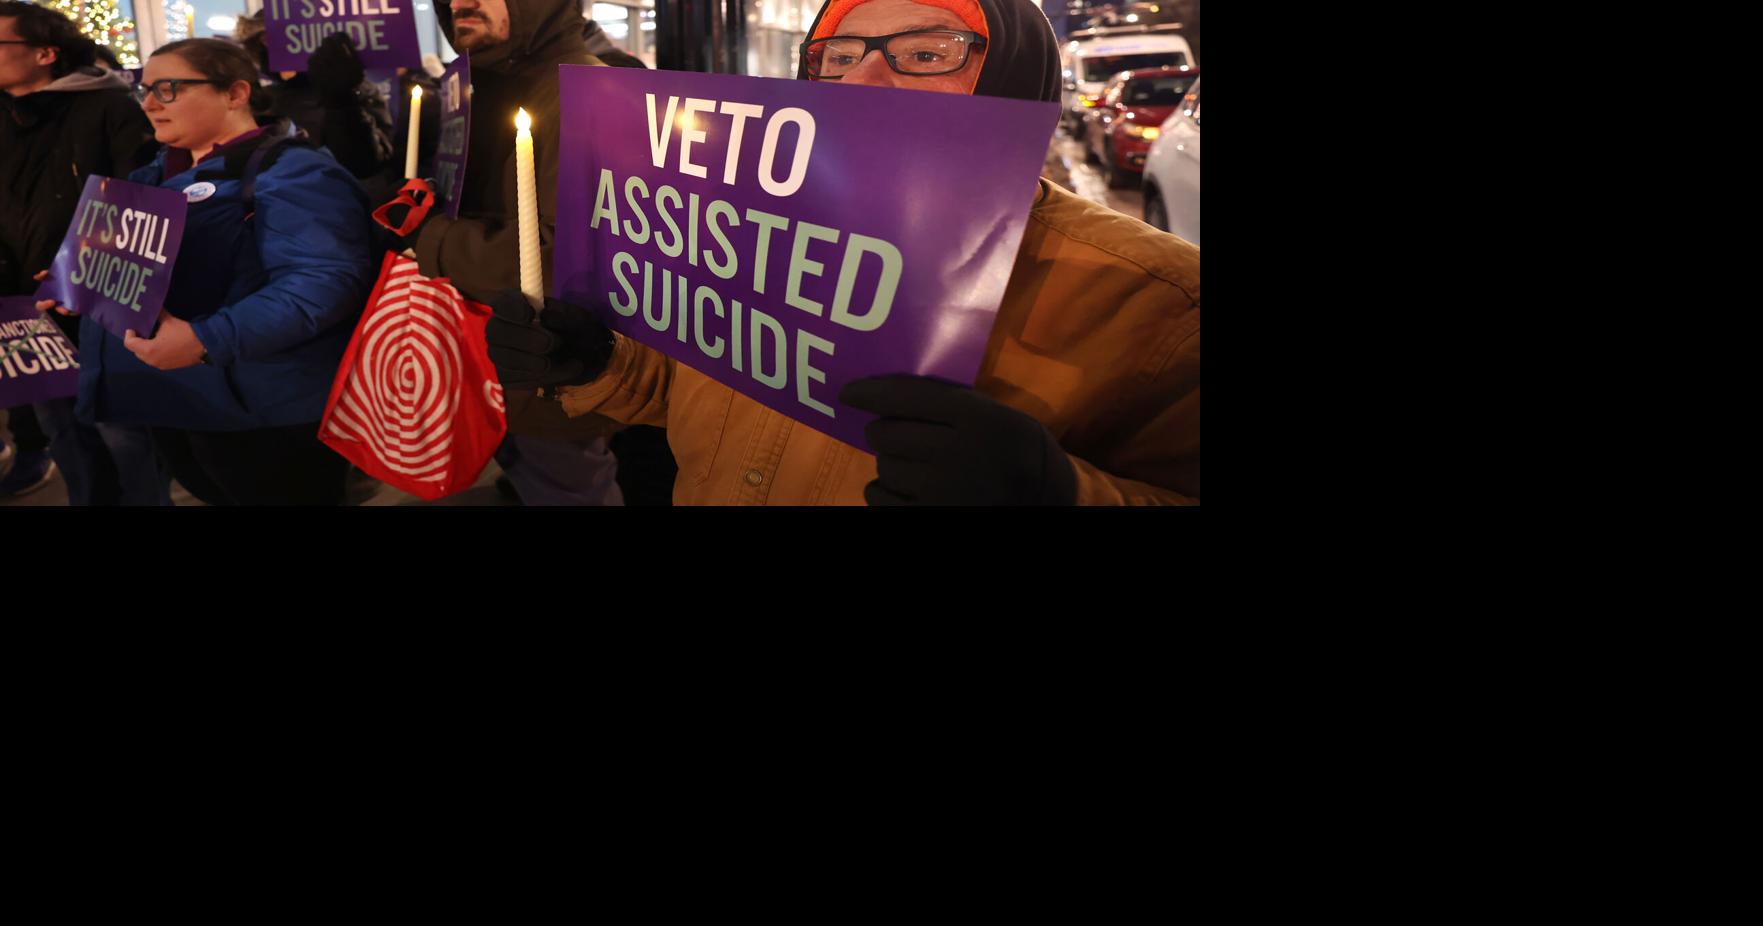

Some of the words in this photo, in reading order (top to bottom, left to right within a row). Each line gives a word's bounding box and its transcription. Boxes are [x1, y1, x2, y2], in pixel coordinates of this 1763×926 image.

[271, 0, 315, 20] ITS
[319, 0, 400, 17] STILL
[645, 93, 817, 197] VETO
[76, 199, 118, 244] IT'S
[115, 207, 170, 265] STILL
[590, 168, 904, 332] ASSISTED
[70, 246, 153, 313] SUICIDE
[608, 251, 836, 419] SUICIDE
